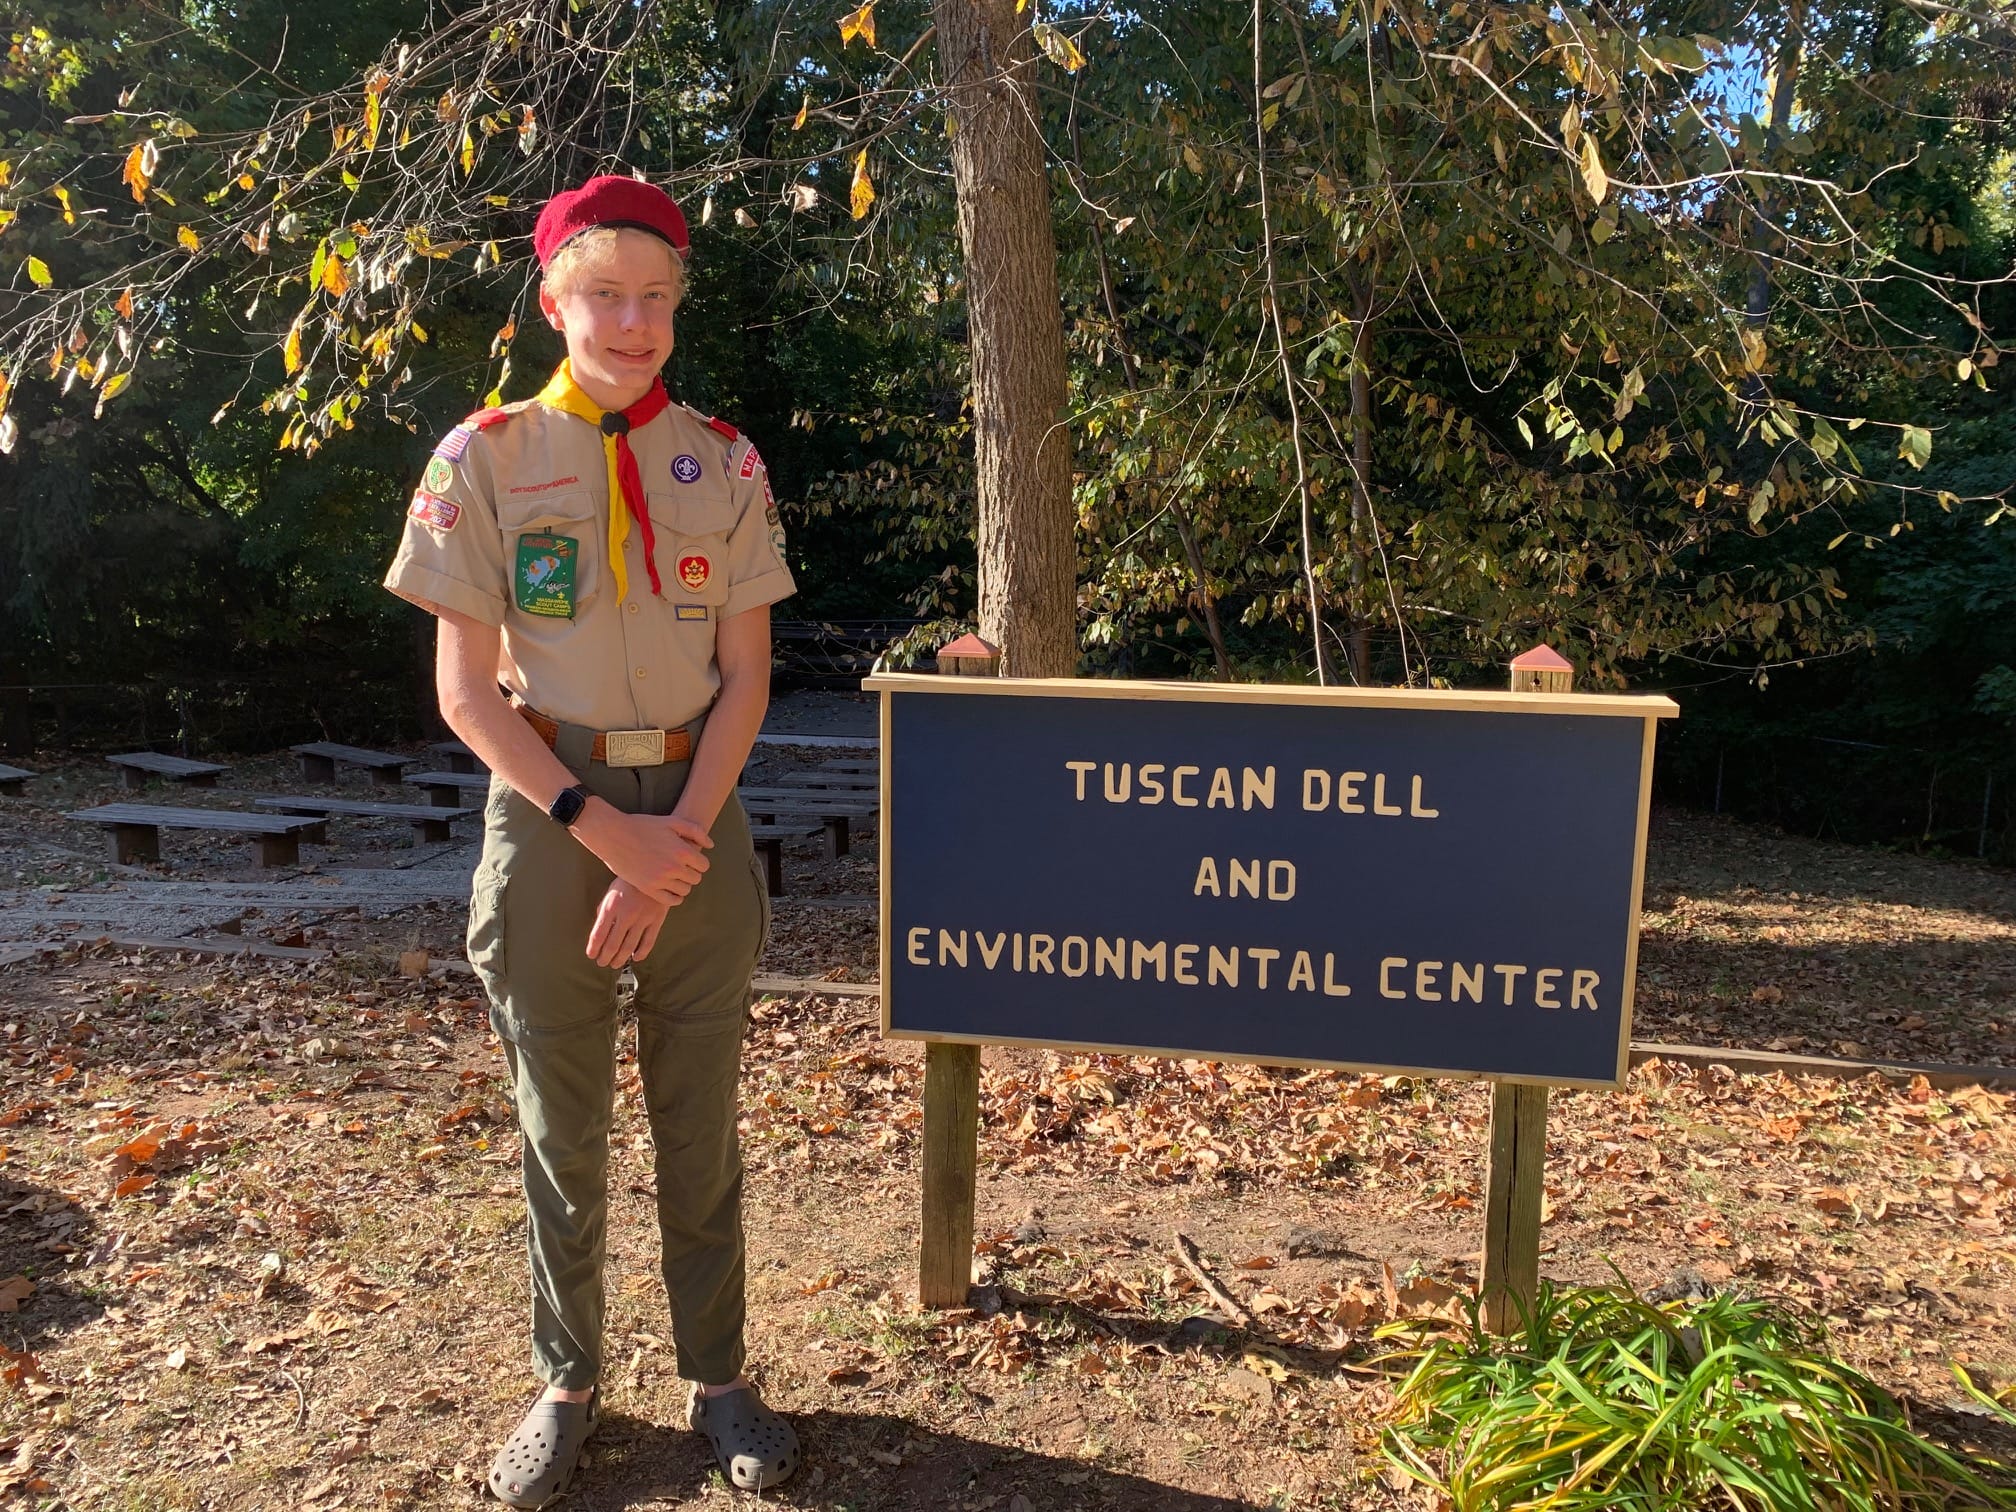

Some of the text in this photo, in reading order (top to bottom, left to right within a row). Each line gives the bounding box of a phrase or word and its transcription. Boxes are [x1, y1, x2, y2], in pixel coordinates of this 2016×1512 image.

[552, 476, 579, 488] AMERICA
[1066, 762, 1439, 818] TUSCAN DELL
[1194, 857, 1298, 900] AND
[908, 928, 1599, 1010] ENVIRONMENTAL CENTER
